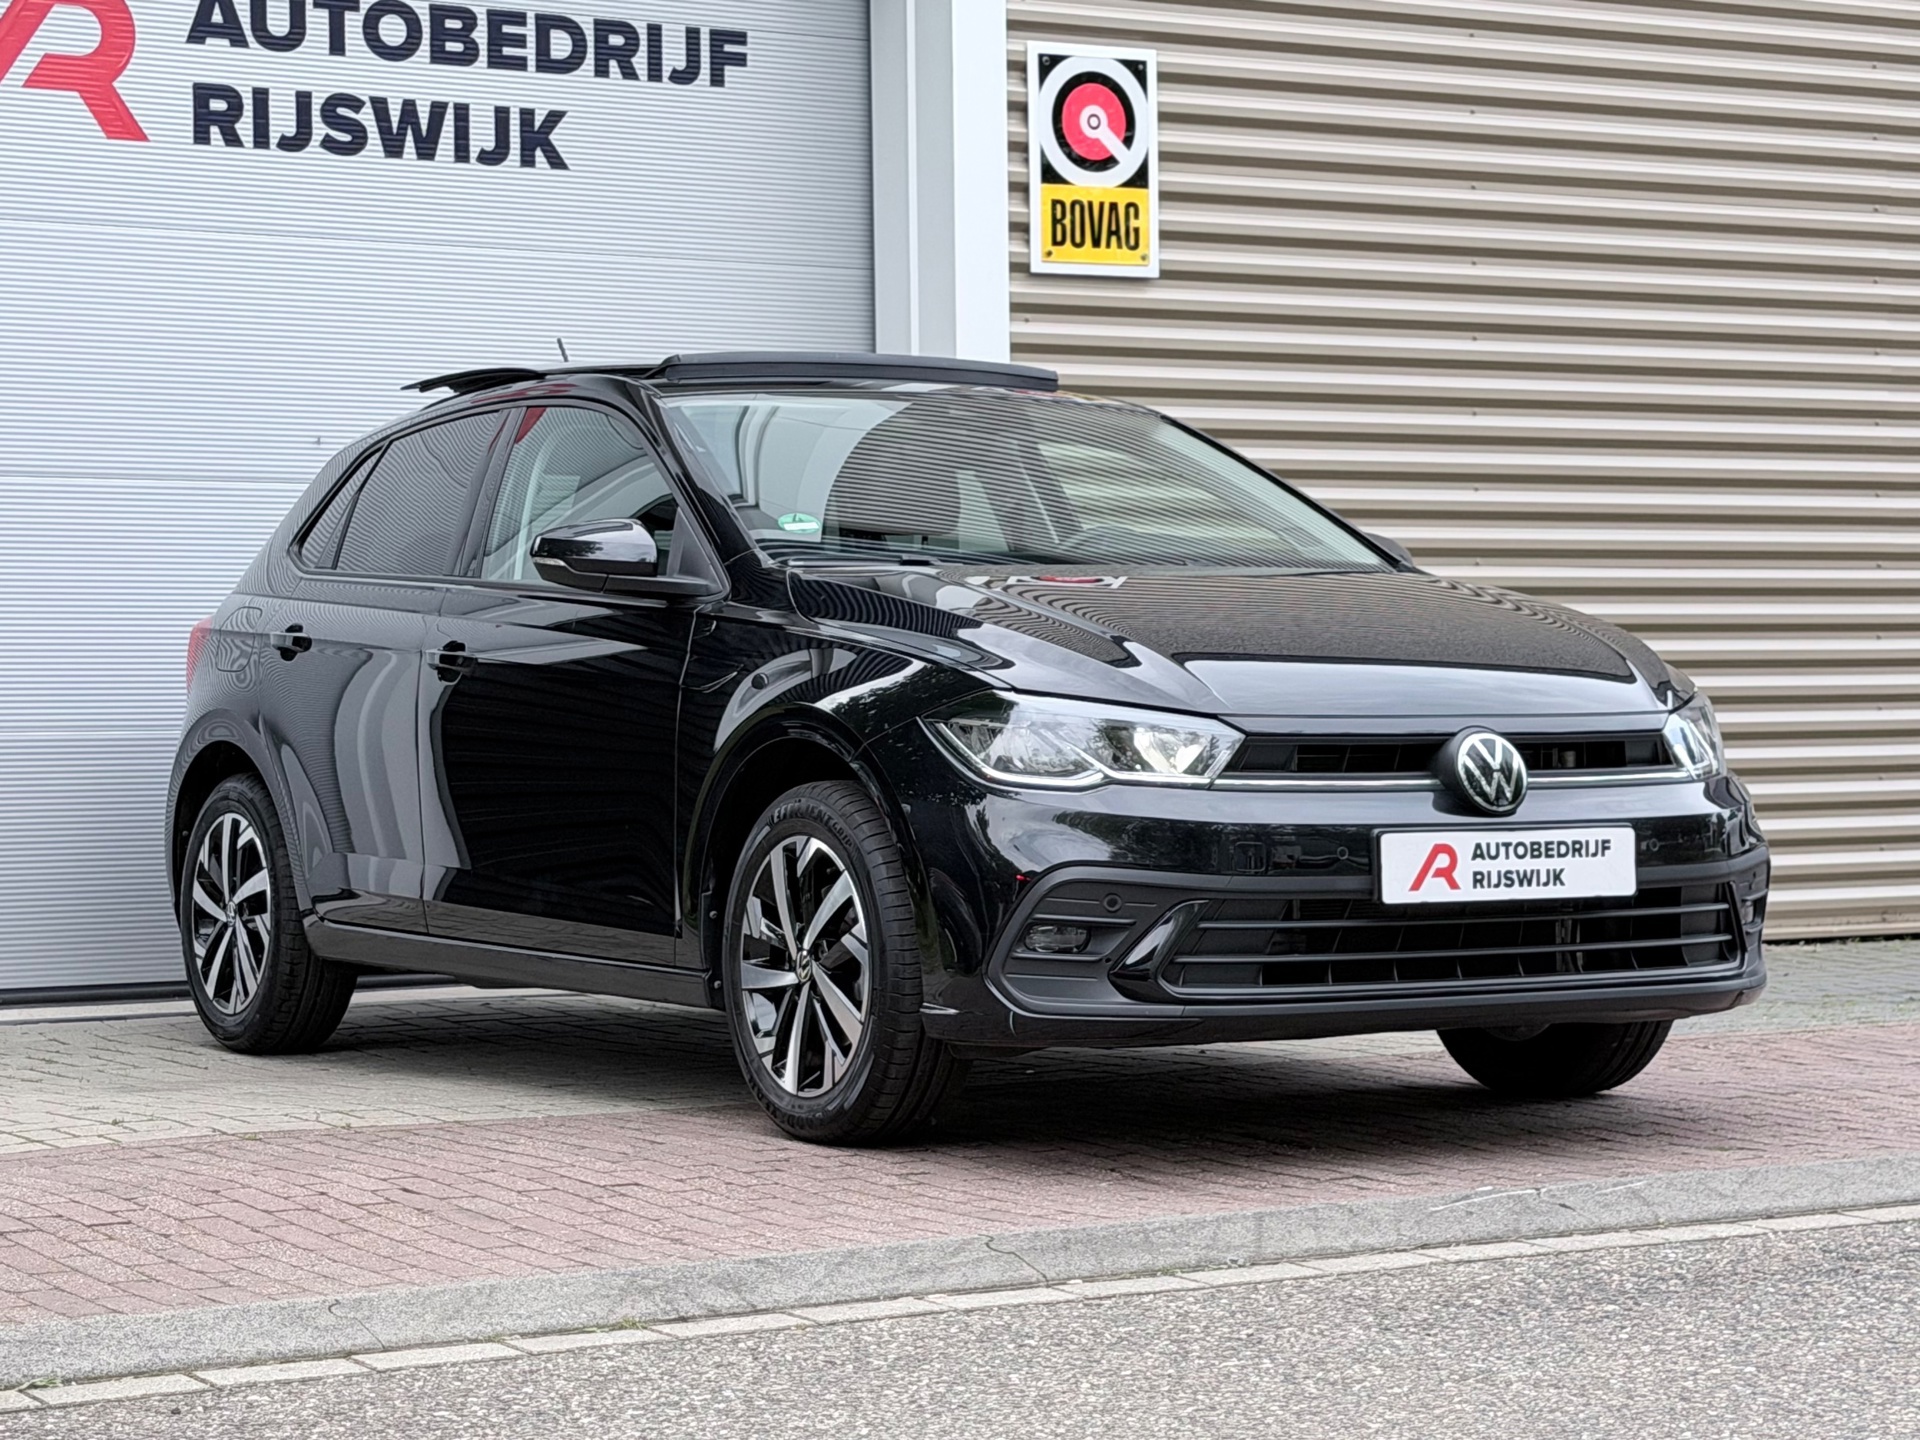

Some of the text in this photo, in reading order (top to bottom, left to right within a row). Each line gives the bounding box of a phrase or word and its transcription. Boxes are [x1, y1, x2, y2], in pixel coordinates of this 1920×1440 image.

[187, 0, 748, 87] AUTOBEDRIJF
[193, 82, 570, 170] RIJSWIJK
[1050, 198, 1140, 251] BOVAG
[1471, 839, 1611, 861] AUTOBEDRIJF
[1472, 868, 1566, 889] RIJSWIJK
